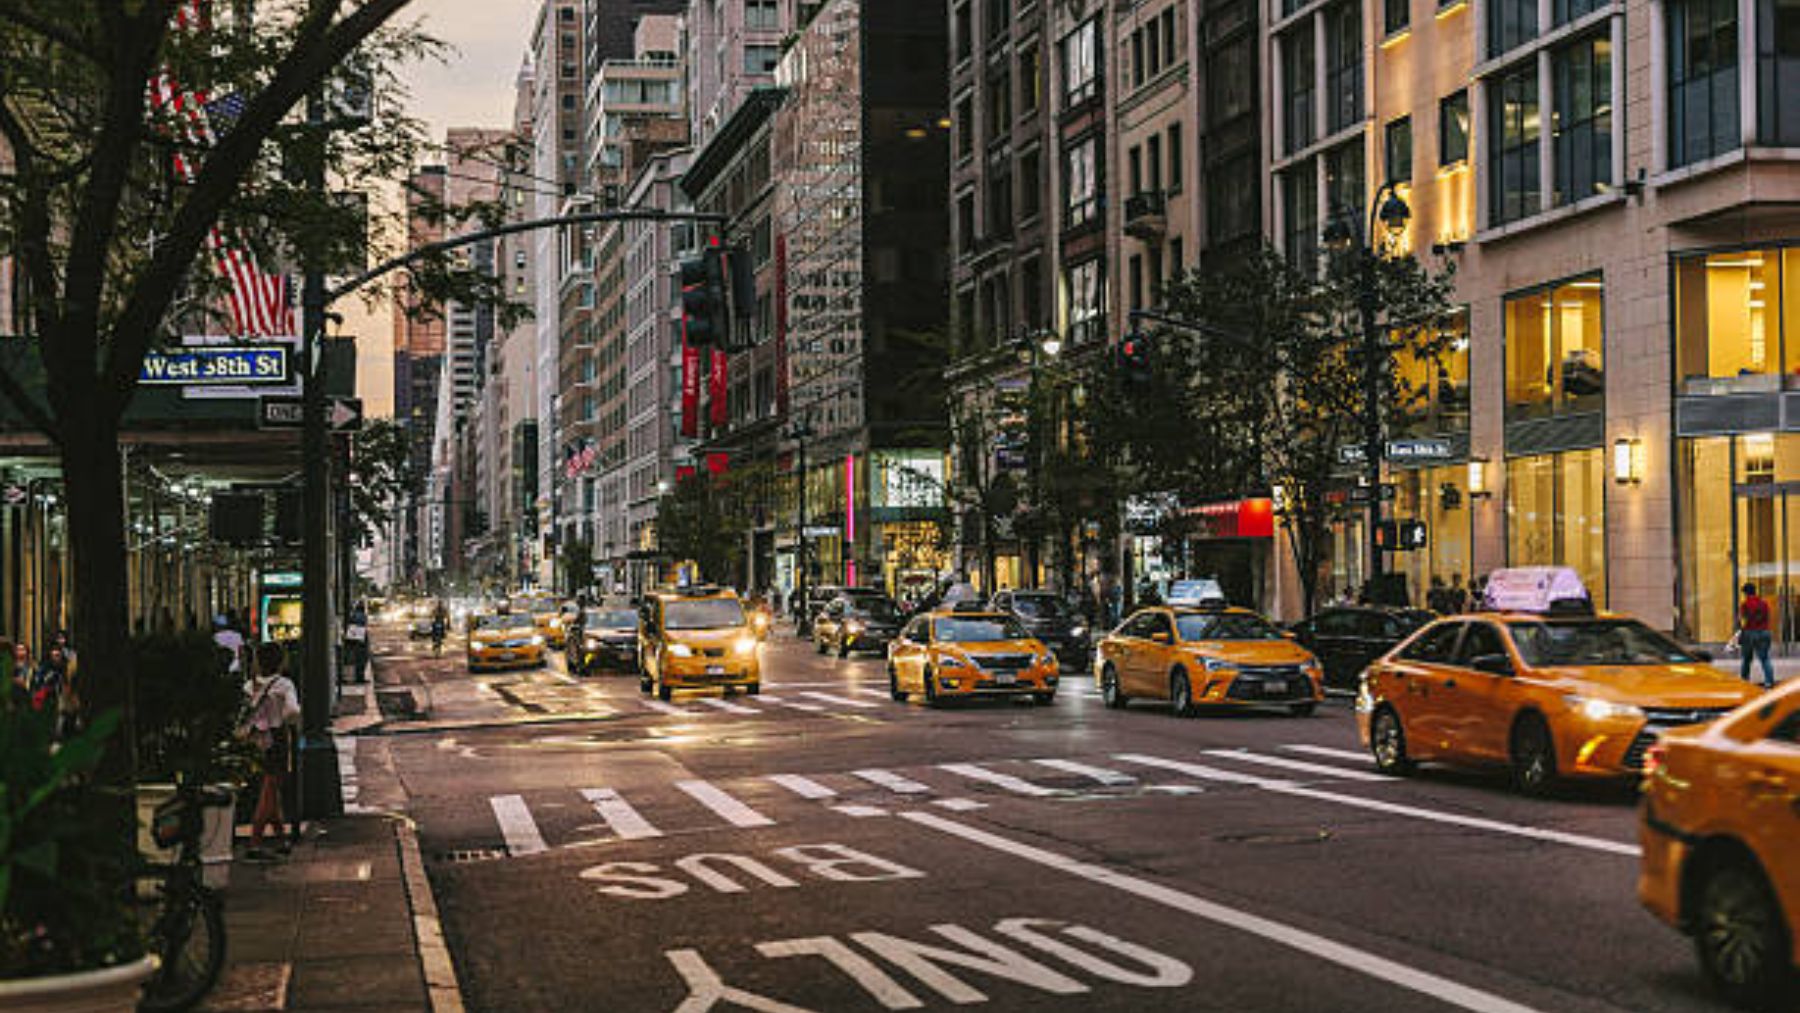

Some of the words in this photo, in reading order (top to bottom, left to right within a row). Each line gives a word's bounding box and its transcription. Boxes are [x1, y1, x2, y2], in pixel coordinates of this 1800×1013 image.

[143, 357, 199, 376] West
[203, 355, 250, 375] 38th
[255, 355, 279, 375] St
[579, 843, 927, 899] BUS
[664, 918, 1194, 1013] ONLY
